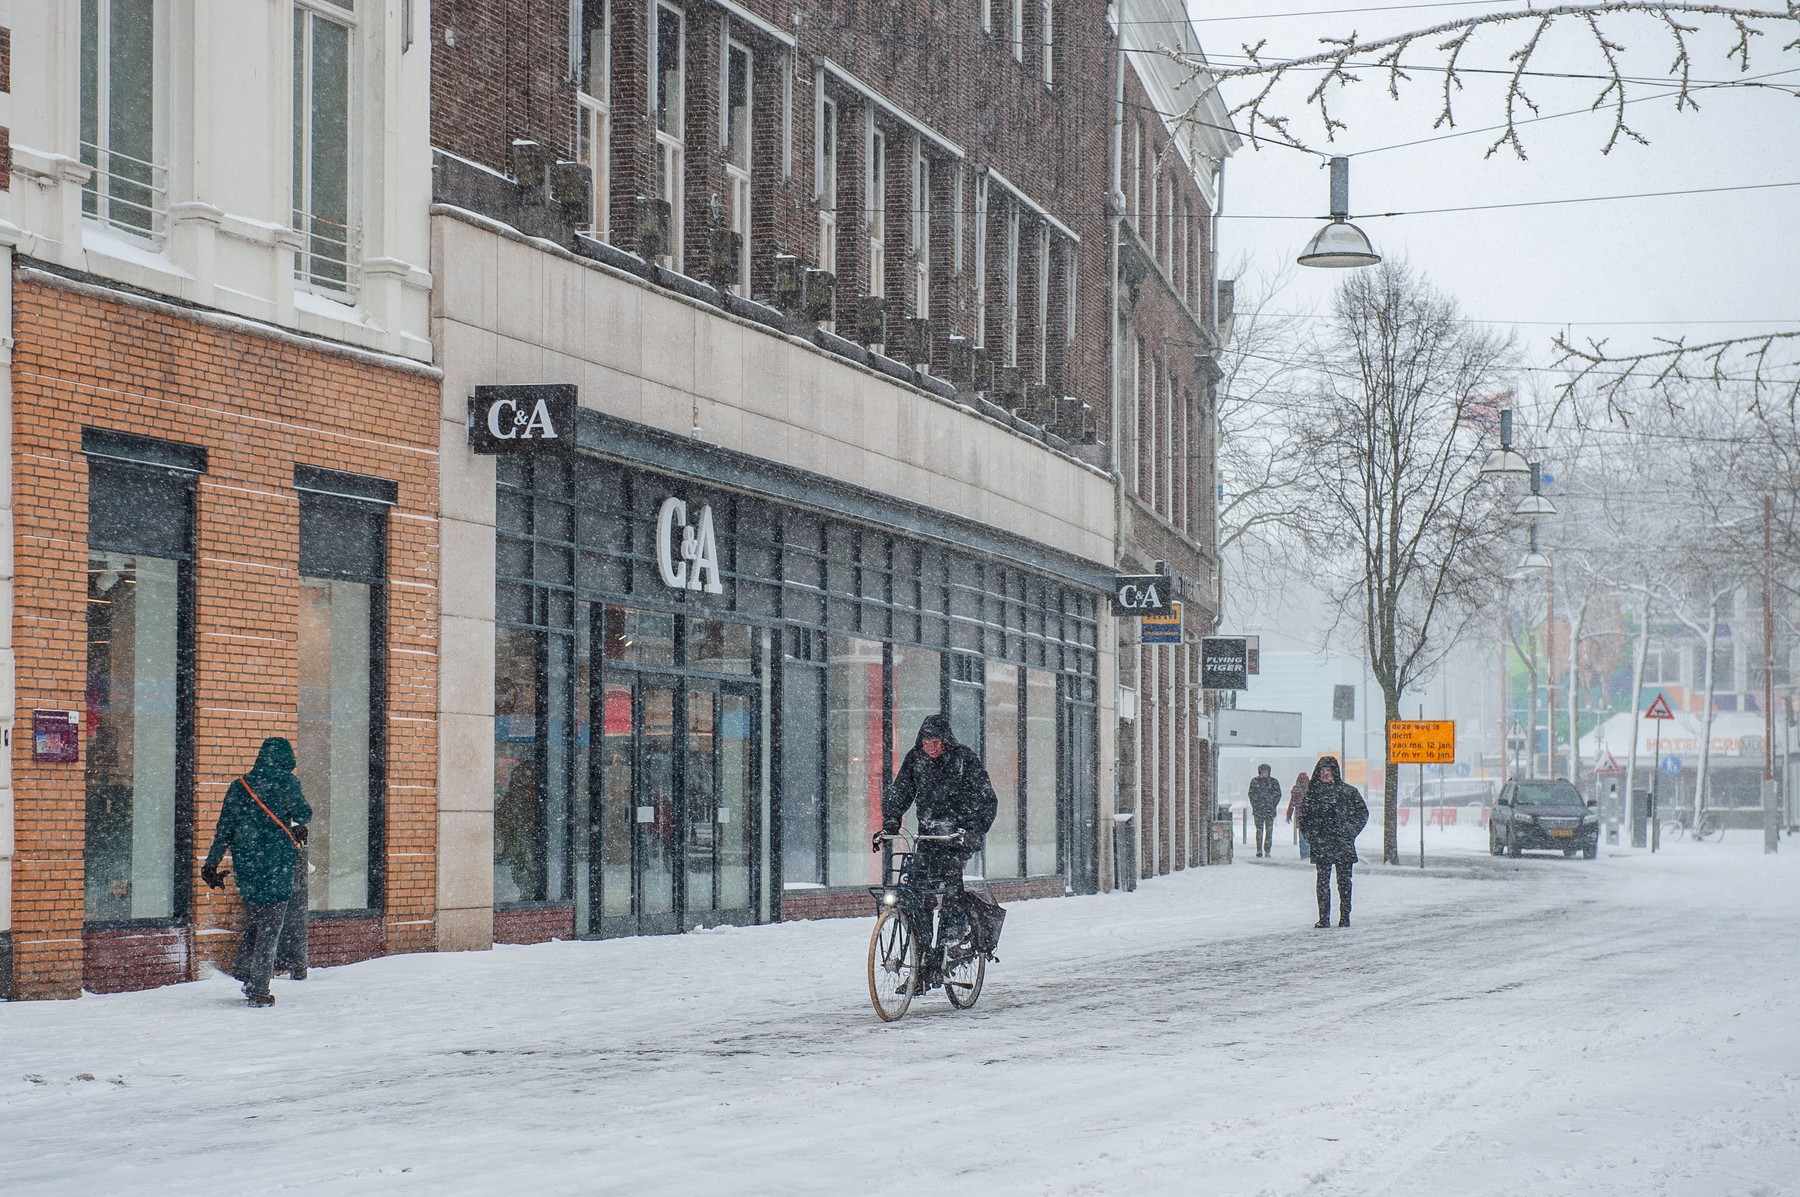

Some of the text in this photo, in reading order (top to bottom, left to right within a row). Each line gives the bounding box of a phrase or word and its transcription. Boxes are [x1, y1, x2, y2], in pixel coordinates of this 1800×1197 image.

[487, 398, 558, 440] C&A
[656, 496, 723, 594] C&A
[1118, 584, 1163, 608] C&A
[1205, 664, 1244, 672] TIGER
[1206, 656, 1243, 664] FLYING
[1646, 736, 1698, 752] HOTEL
